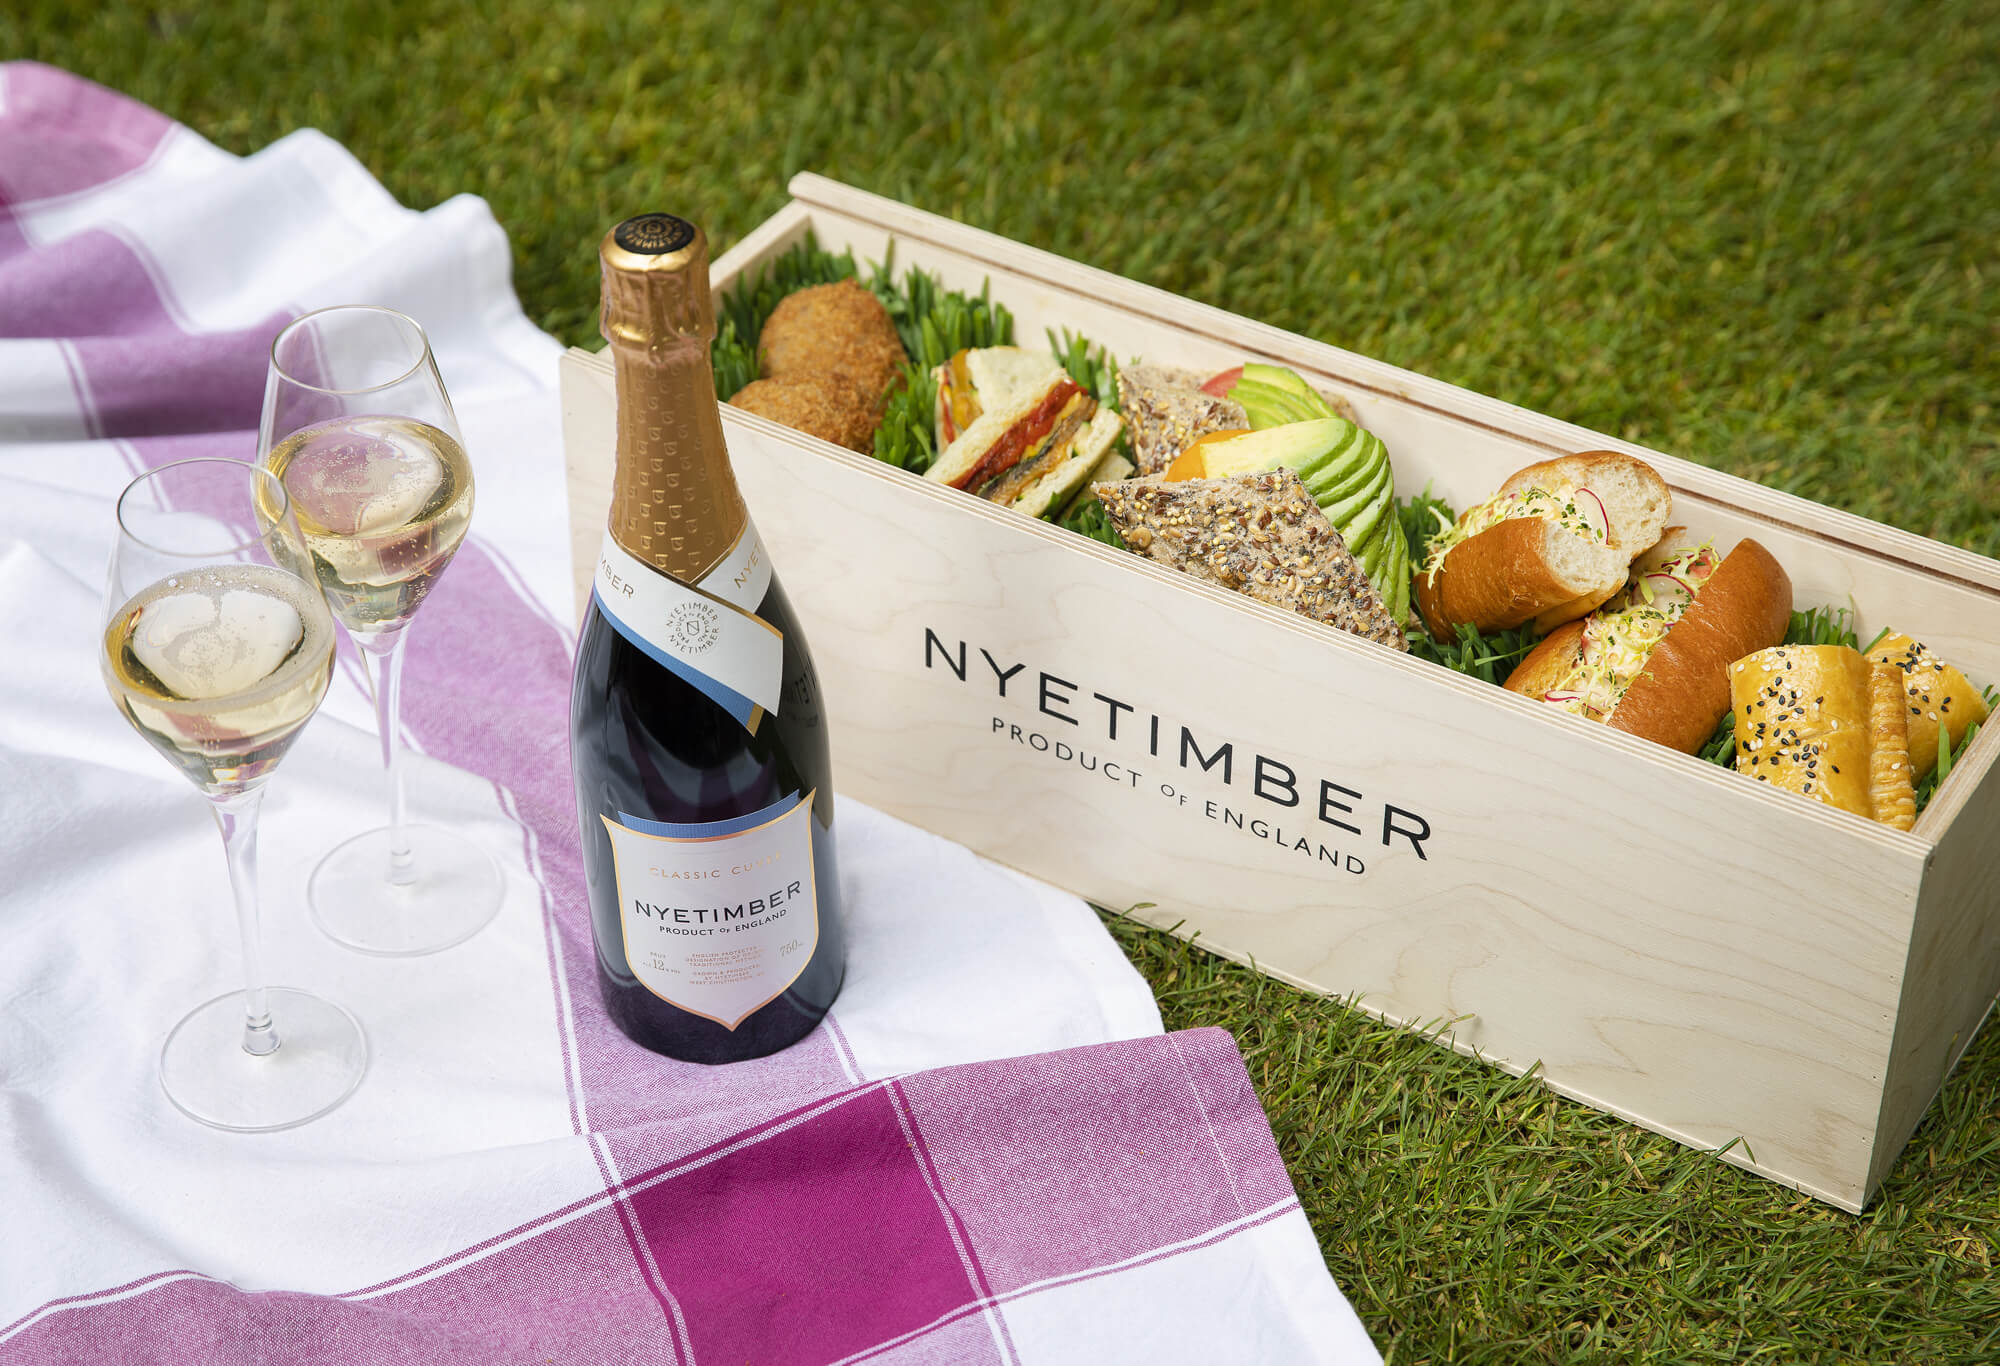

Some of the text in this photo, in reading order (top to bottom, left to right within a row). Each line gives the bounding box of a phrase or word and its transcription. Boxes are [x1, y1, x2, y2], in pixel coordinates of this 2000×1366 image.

[925, 627, 1432, 861] NYETIMBER
[992, 717, 1367, 875] PRODUCT OF ENGLAND
[649, 867, 721, 880] CLASSIC
[635, 880, 801, 924] NYETIMBER
[659, 925, 715, 936] PRODUCT
[735, 909, 787, 932] ENGLAND
[653, 959, 665, 971] 12
